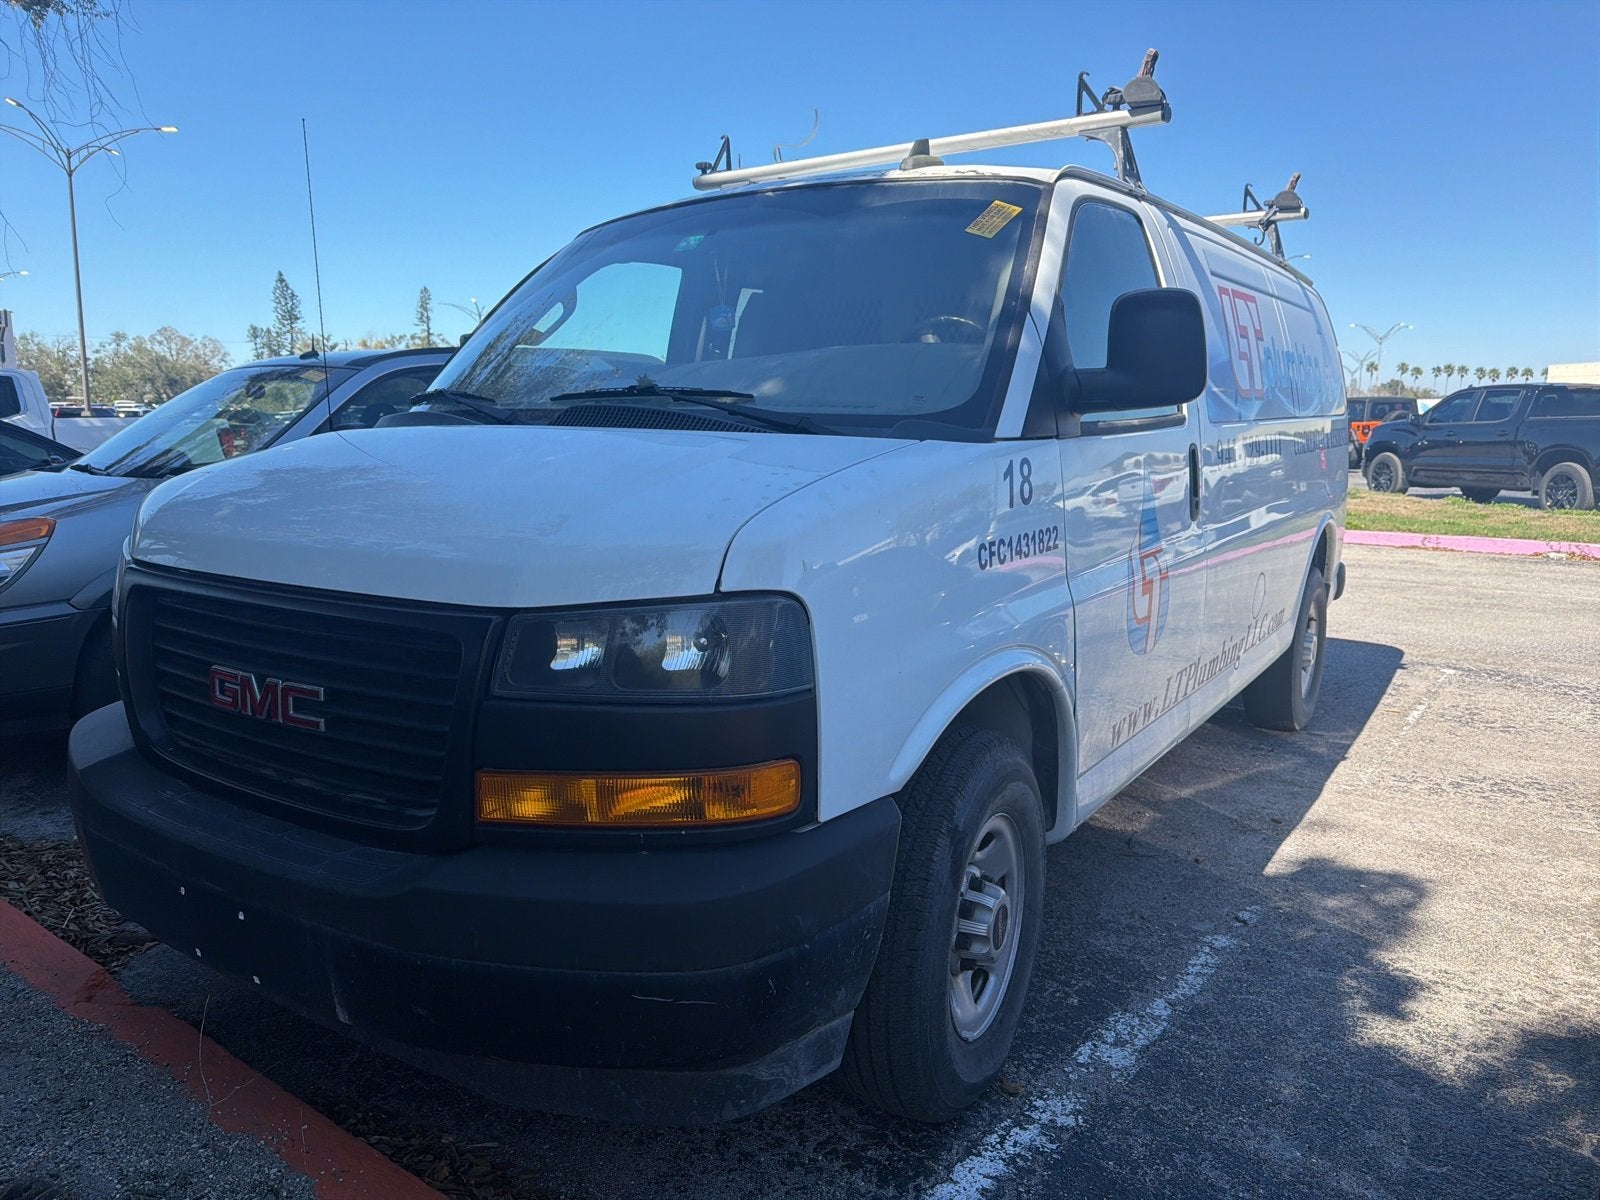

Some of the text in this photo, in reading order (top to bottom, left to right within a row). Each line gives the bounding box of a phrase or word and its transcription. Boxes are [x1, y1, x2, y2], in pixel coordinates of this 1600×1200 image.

[1003, 457, 1033, 508] 18
[978, 526, 1059, 570] CFC1431822
[209, 664, 326, 732] GMC
